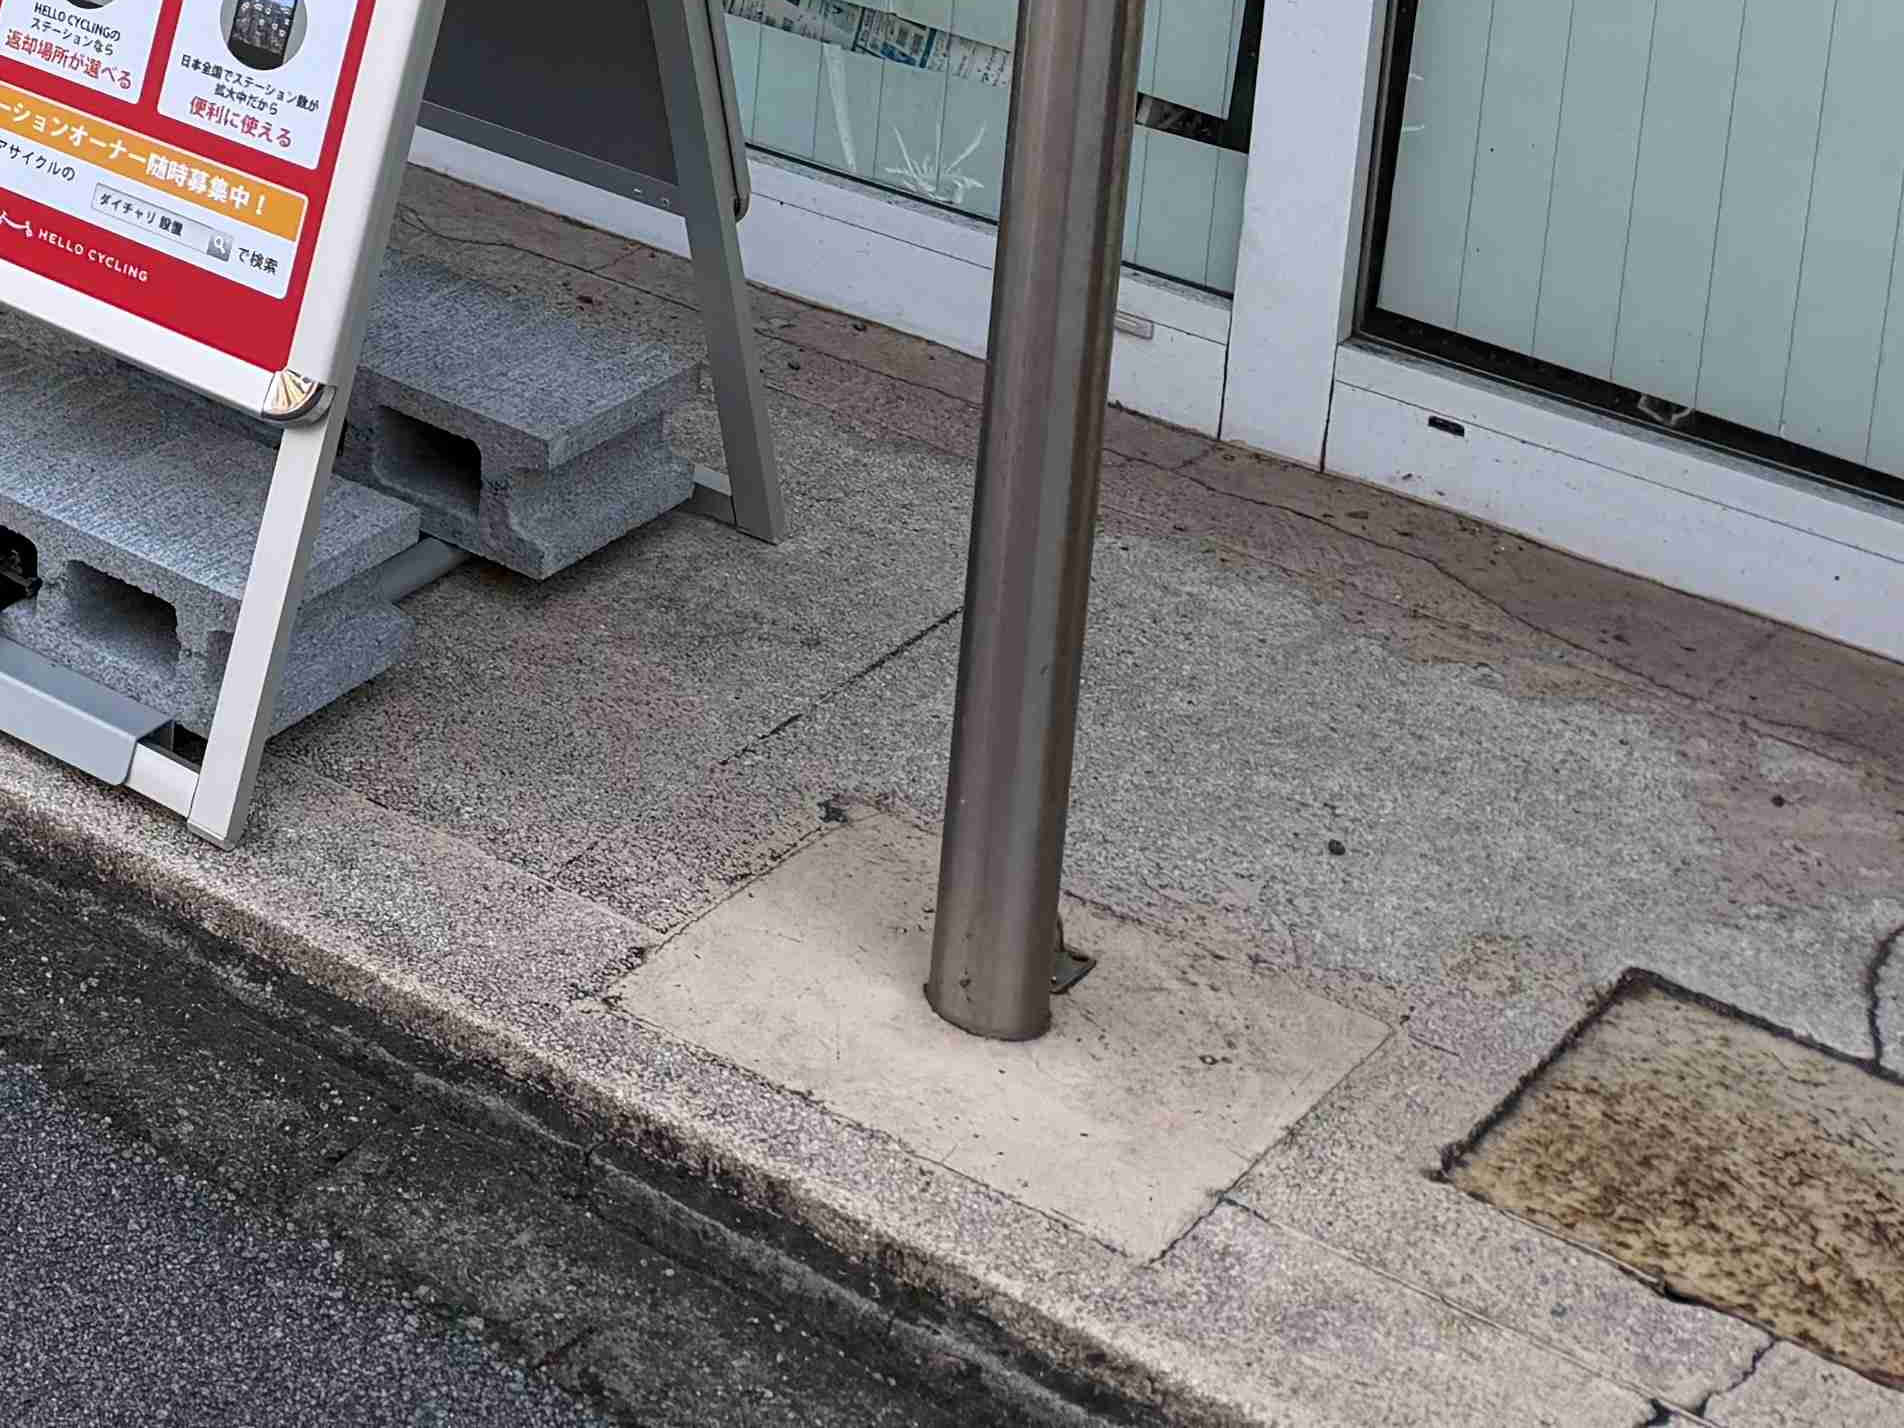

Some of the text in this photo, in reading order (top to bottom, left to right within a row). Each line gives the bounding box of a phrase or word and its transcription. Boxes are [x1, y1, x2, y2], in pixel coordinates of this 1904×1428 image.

[30, 17, 115, 57] ステーションなら
[33, 1, 122, 42] HELLO CYCLINGの
[5, 27, 133, 90] 返却場所が選べる
[180, 53, 320, 113] 日本全国でステーション数が
[213, 82, 279, 116] 拡大中だから
[189, 95, 293, 149] 便利に使える
[97, 191, 156, 226] ダイチャリ
[37, 228, 150, 283] HELLO CYCLING
[236, 245, 279, 276] で検索
